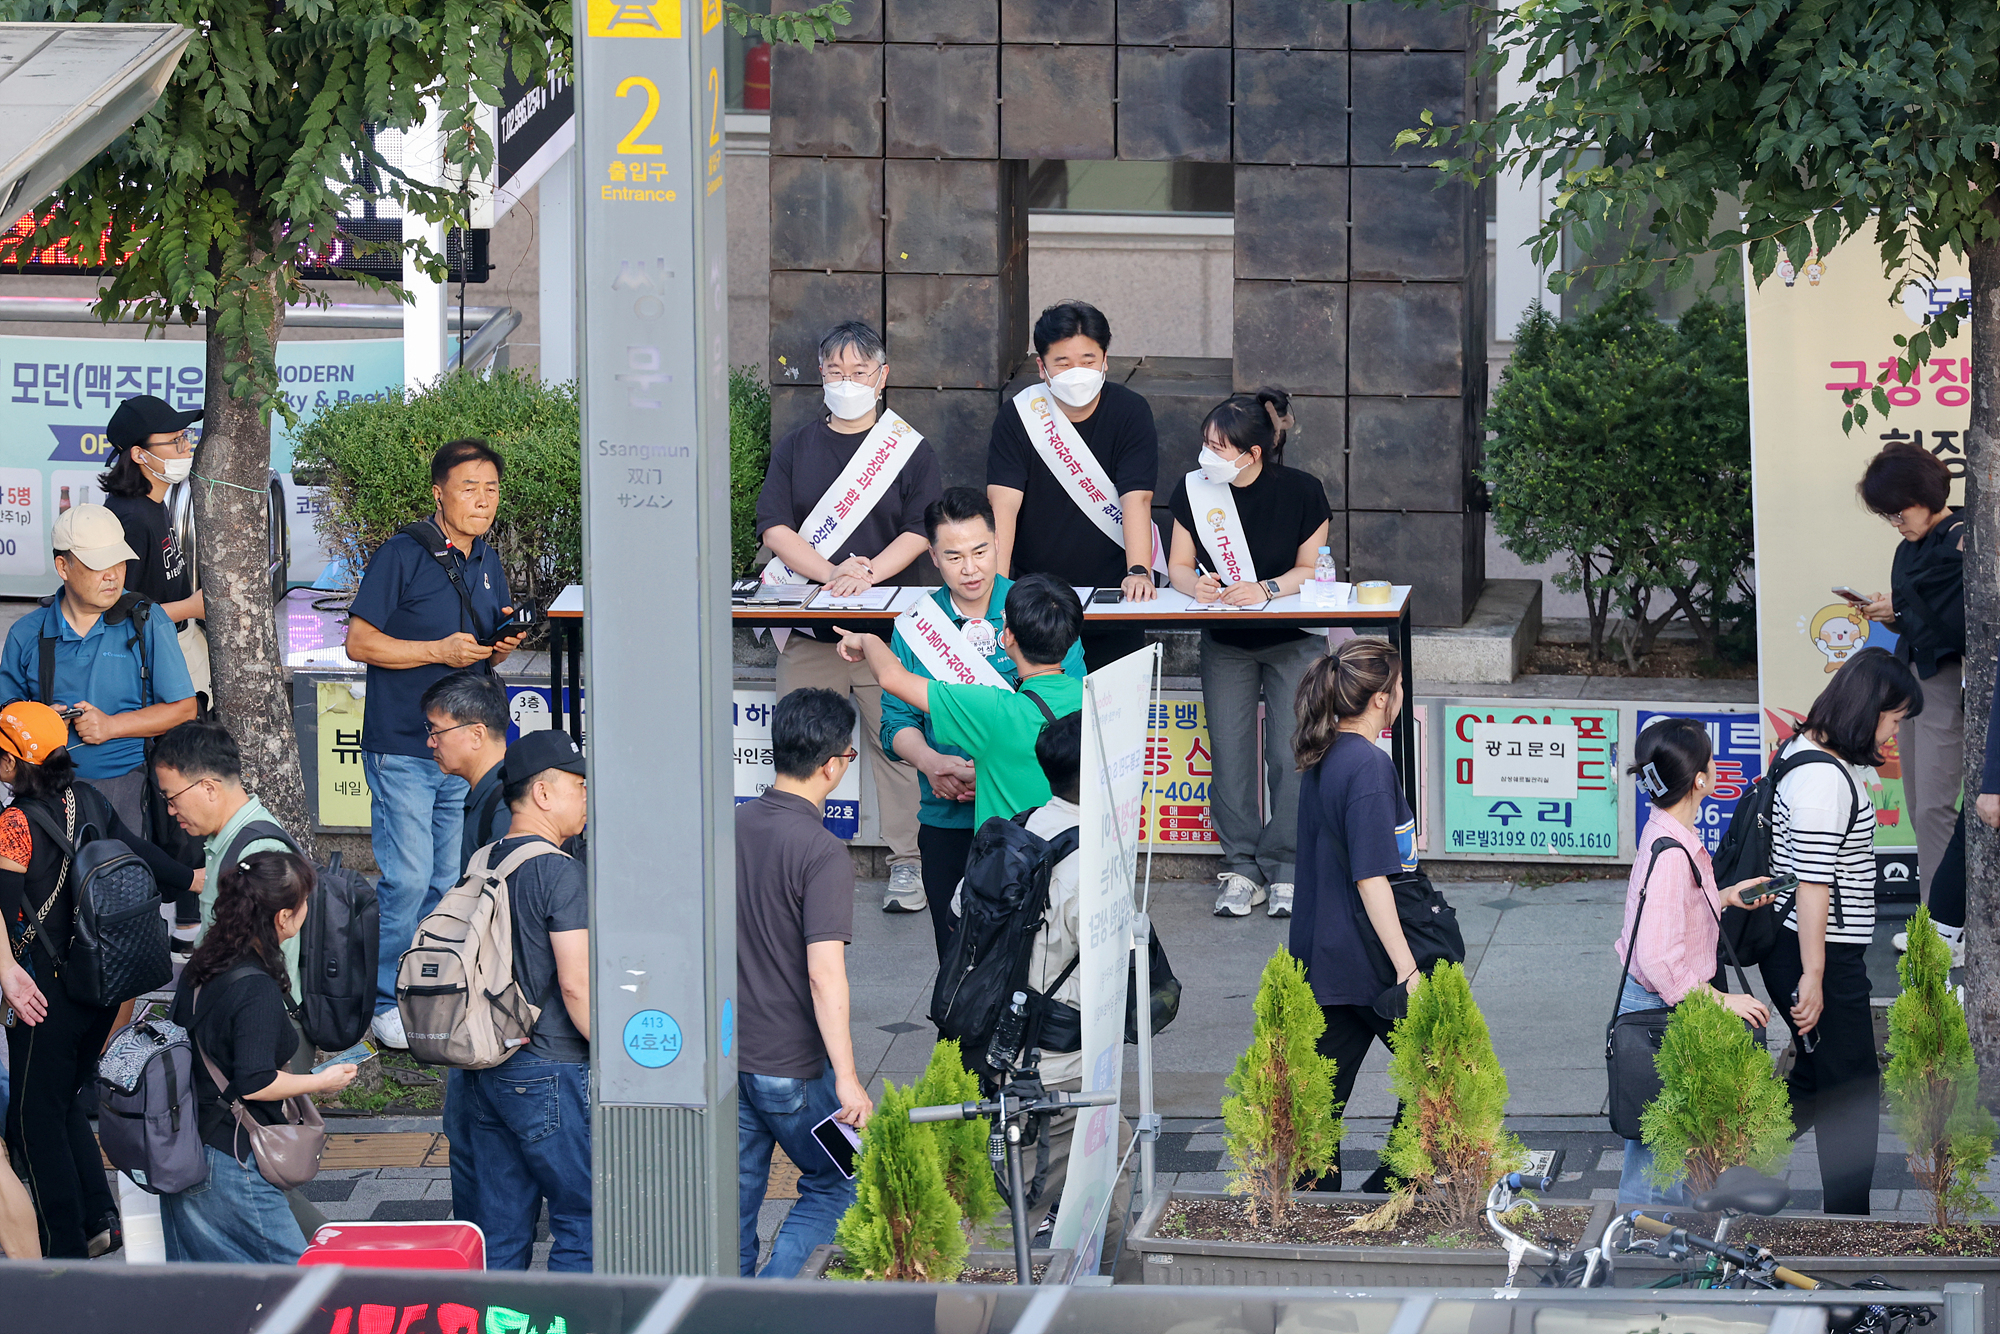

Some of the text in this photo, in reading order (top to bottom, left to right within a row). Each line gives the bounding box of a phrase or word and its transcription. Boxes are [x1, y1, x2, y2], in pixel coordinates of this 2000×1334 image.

[615, 75, 664, 155] 2
[708, 66, 720, 148] 2
[608, 160, 669, 182] 출입구
[601, 184, 676, 202] Entrance
[611, 257, 675, 411] 쌍문
[598, 440, 690, 461] Ssangmun
[1043, 420, 1084, 477] 구청장과
[1078, 476, 1107, 504] 함께
[627, 467, 662, 485] 双门
[8, 486, 31, 507] 5병
[617, 493, 673, 510] サンムン
[809, 436, 898, 550] 구청장과 함께 현장
[1217, 535, 1242, 582] 구청장
[916, 618, 976, 686] 도봉구청장
[519, 695, 540, 709] 3층
[1485, 740, 1566, 759] 광고문의
[334, 781, 362, 797] 네일
[823, 806, 855, 820] 22호
[1487, 800, 1573, 829] 수리
[1452, 829, 1526, 848] 쉐르빌319호
[641, 1016, 664, 1029] 413
[629, 1033, 678, 1052] 4호선
